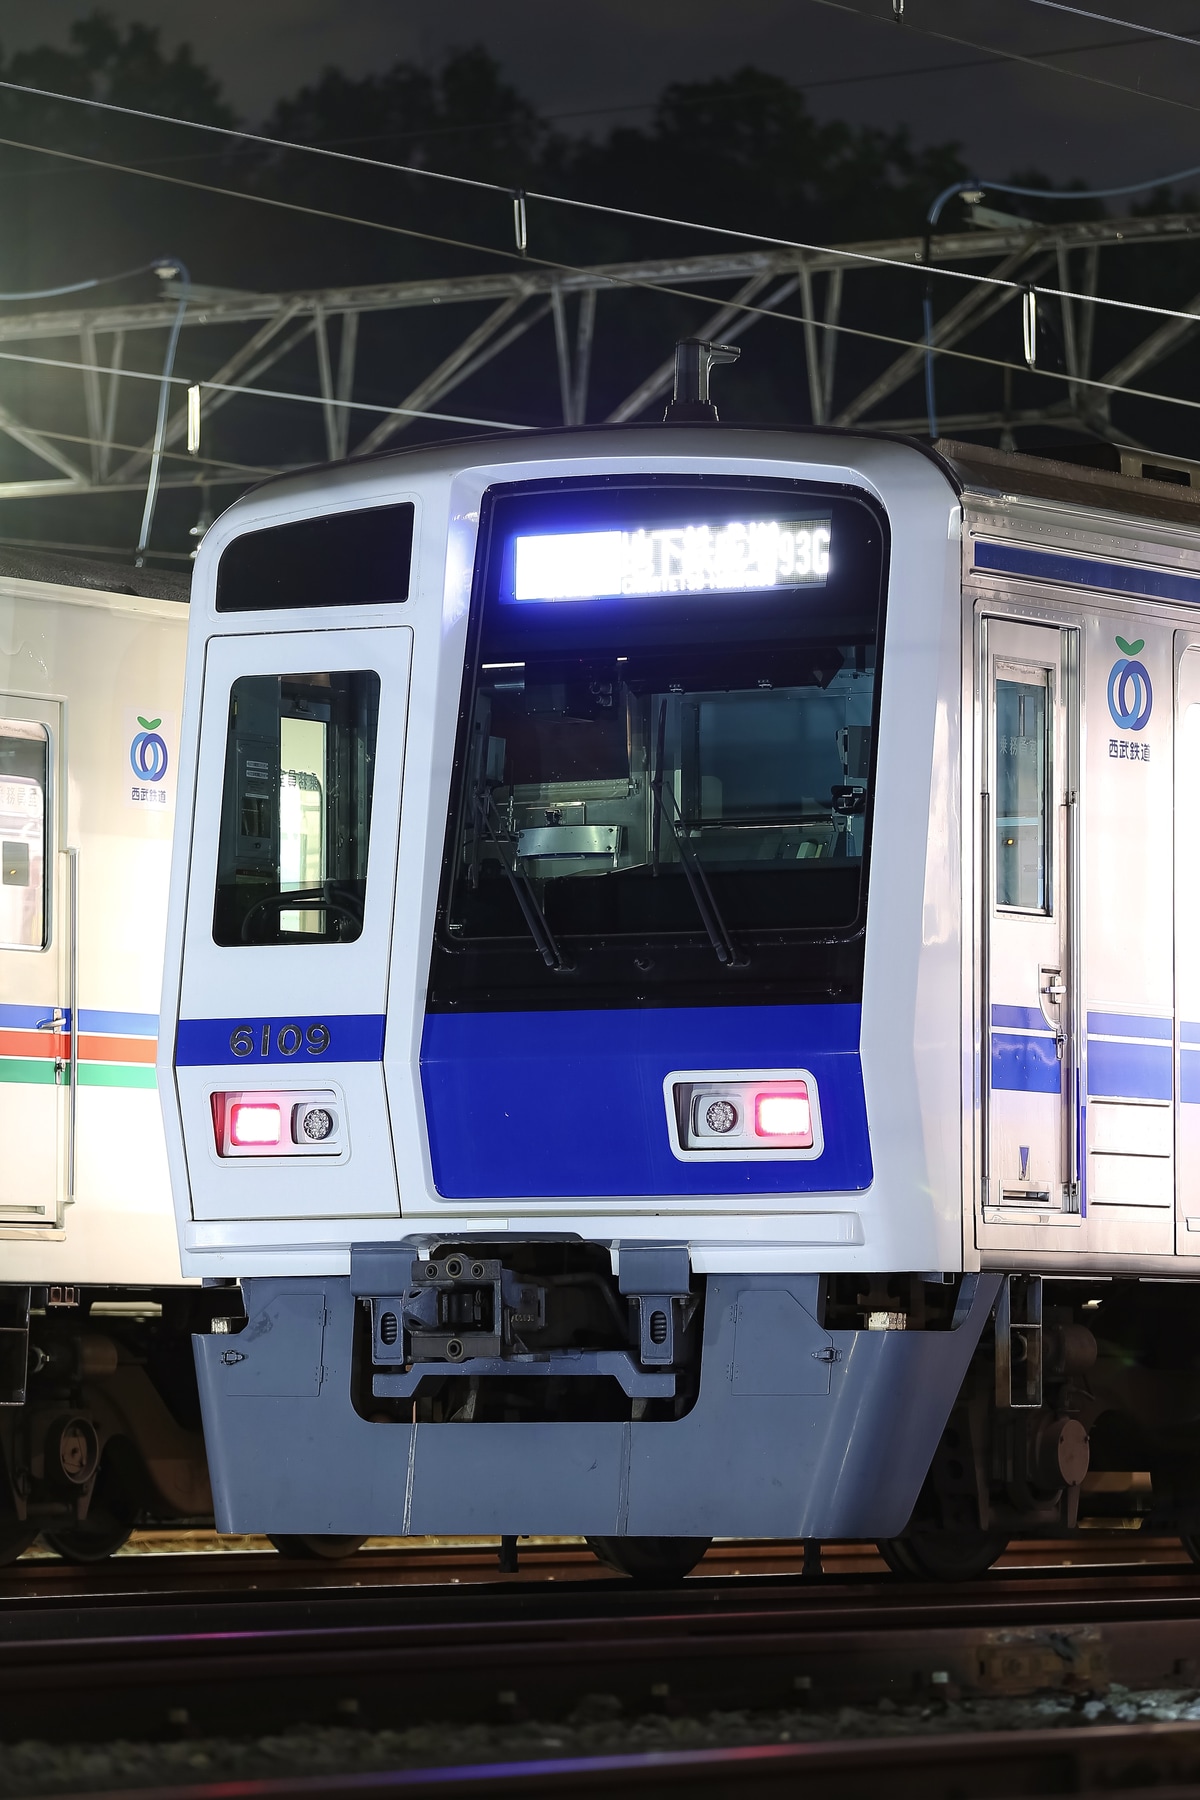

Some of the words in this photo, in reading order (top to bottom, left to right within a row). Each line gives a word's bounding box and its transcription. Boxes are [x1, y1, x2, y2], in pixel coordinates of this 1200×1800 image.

[1109, 739, 1151, 762] 西武鉄道
[131, 787, 167, 804] 西武鉄道
[229, 1023, 331, 1057] 6109
